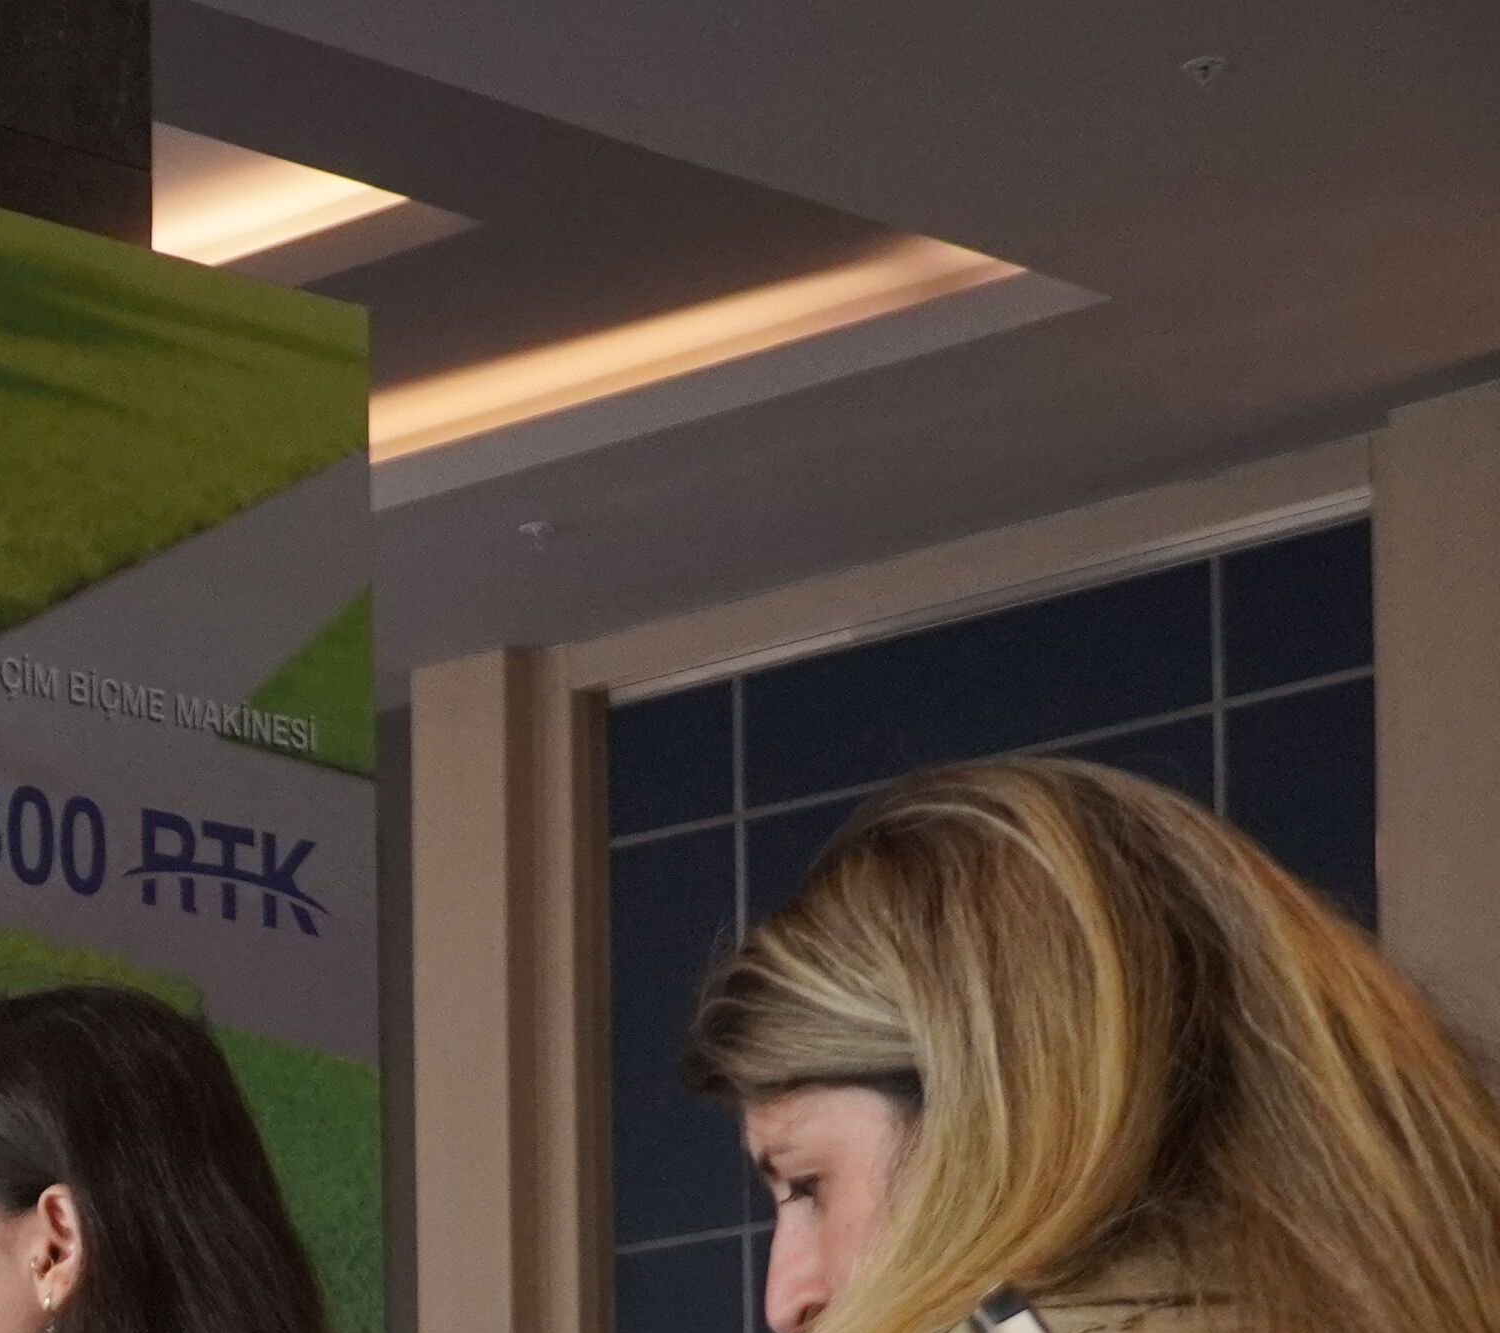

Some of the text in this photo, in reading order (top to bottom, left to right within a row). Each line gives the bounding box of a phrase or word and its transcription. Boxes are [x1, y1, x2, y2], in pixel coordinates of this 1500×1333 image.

[0, 653, 60, 699] ÇİM
[68, 667, 166, 721] BİÇME
[174, 694, 318, 751] MAKİNESİ
[122, 806, 332, 937] RTK
